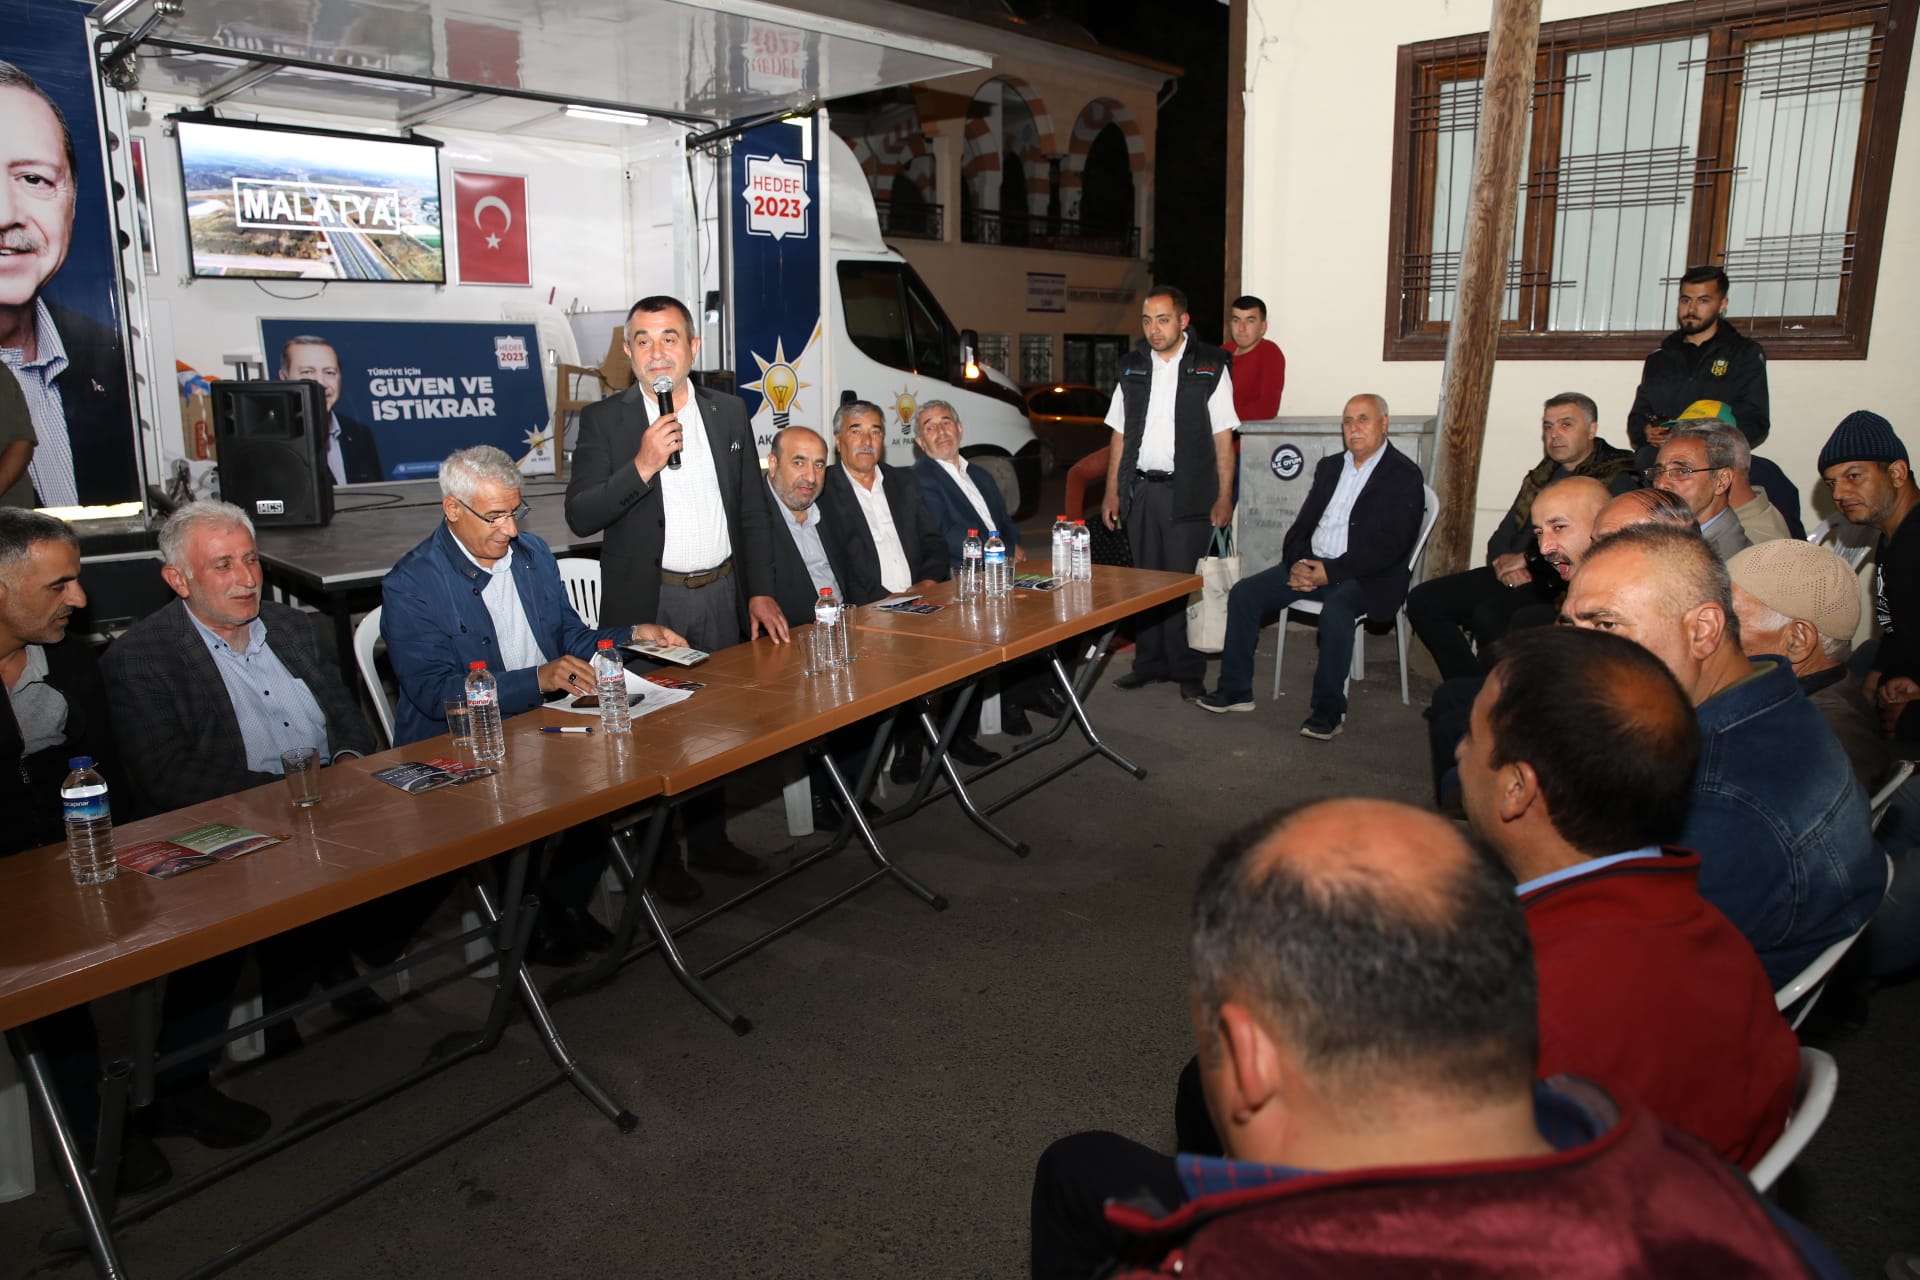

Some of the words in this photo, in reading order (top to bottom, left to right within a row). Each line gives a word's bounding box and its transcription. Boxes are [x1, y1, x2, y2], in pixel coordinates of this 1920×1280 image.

[753, 175, 801, 195] HEDEF
[243, 188, 394, 226] MALATYA
[753, 195, 801, 219] 2023
[501, 352, 524, 361] 2023
[368, 367, 403, 376] TÜRKİYE
[404, 366, 421, 376] İÇİN
[369, 377, 456, 397] GÜVEN
[460, 376, 494, 395] VE
[371, 397, 497, 421] İSTİKRAR
[758, 434, 772, 446] AK
